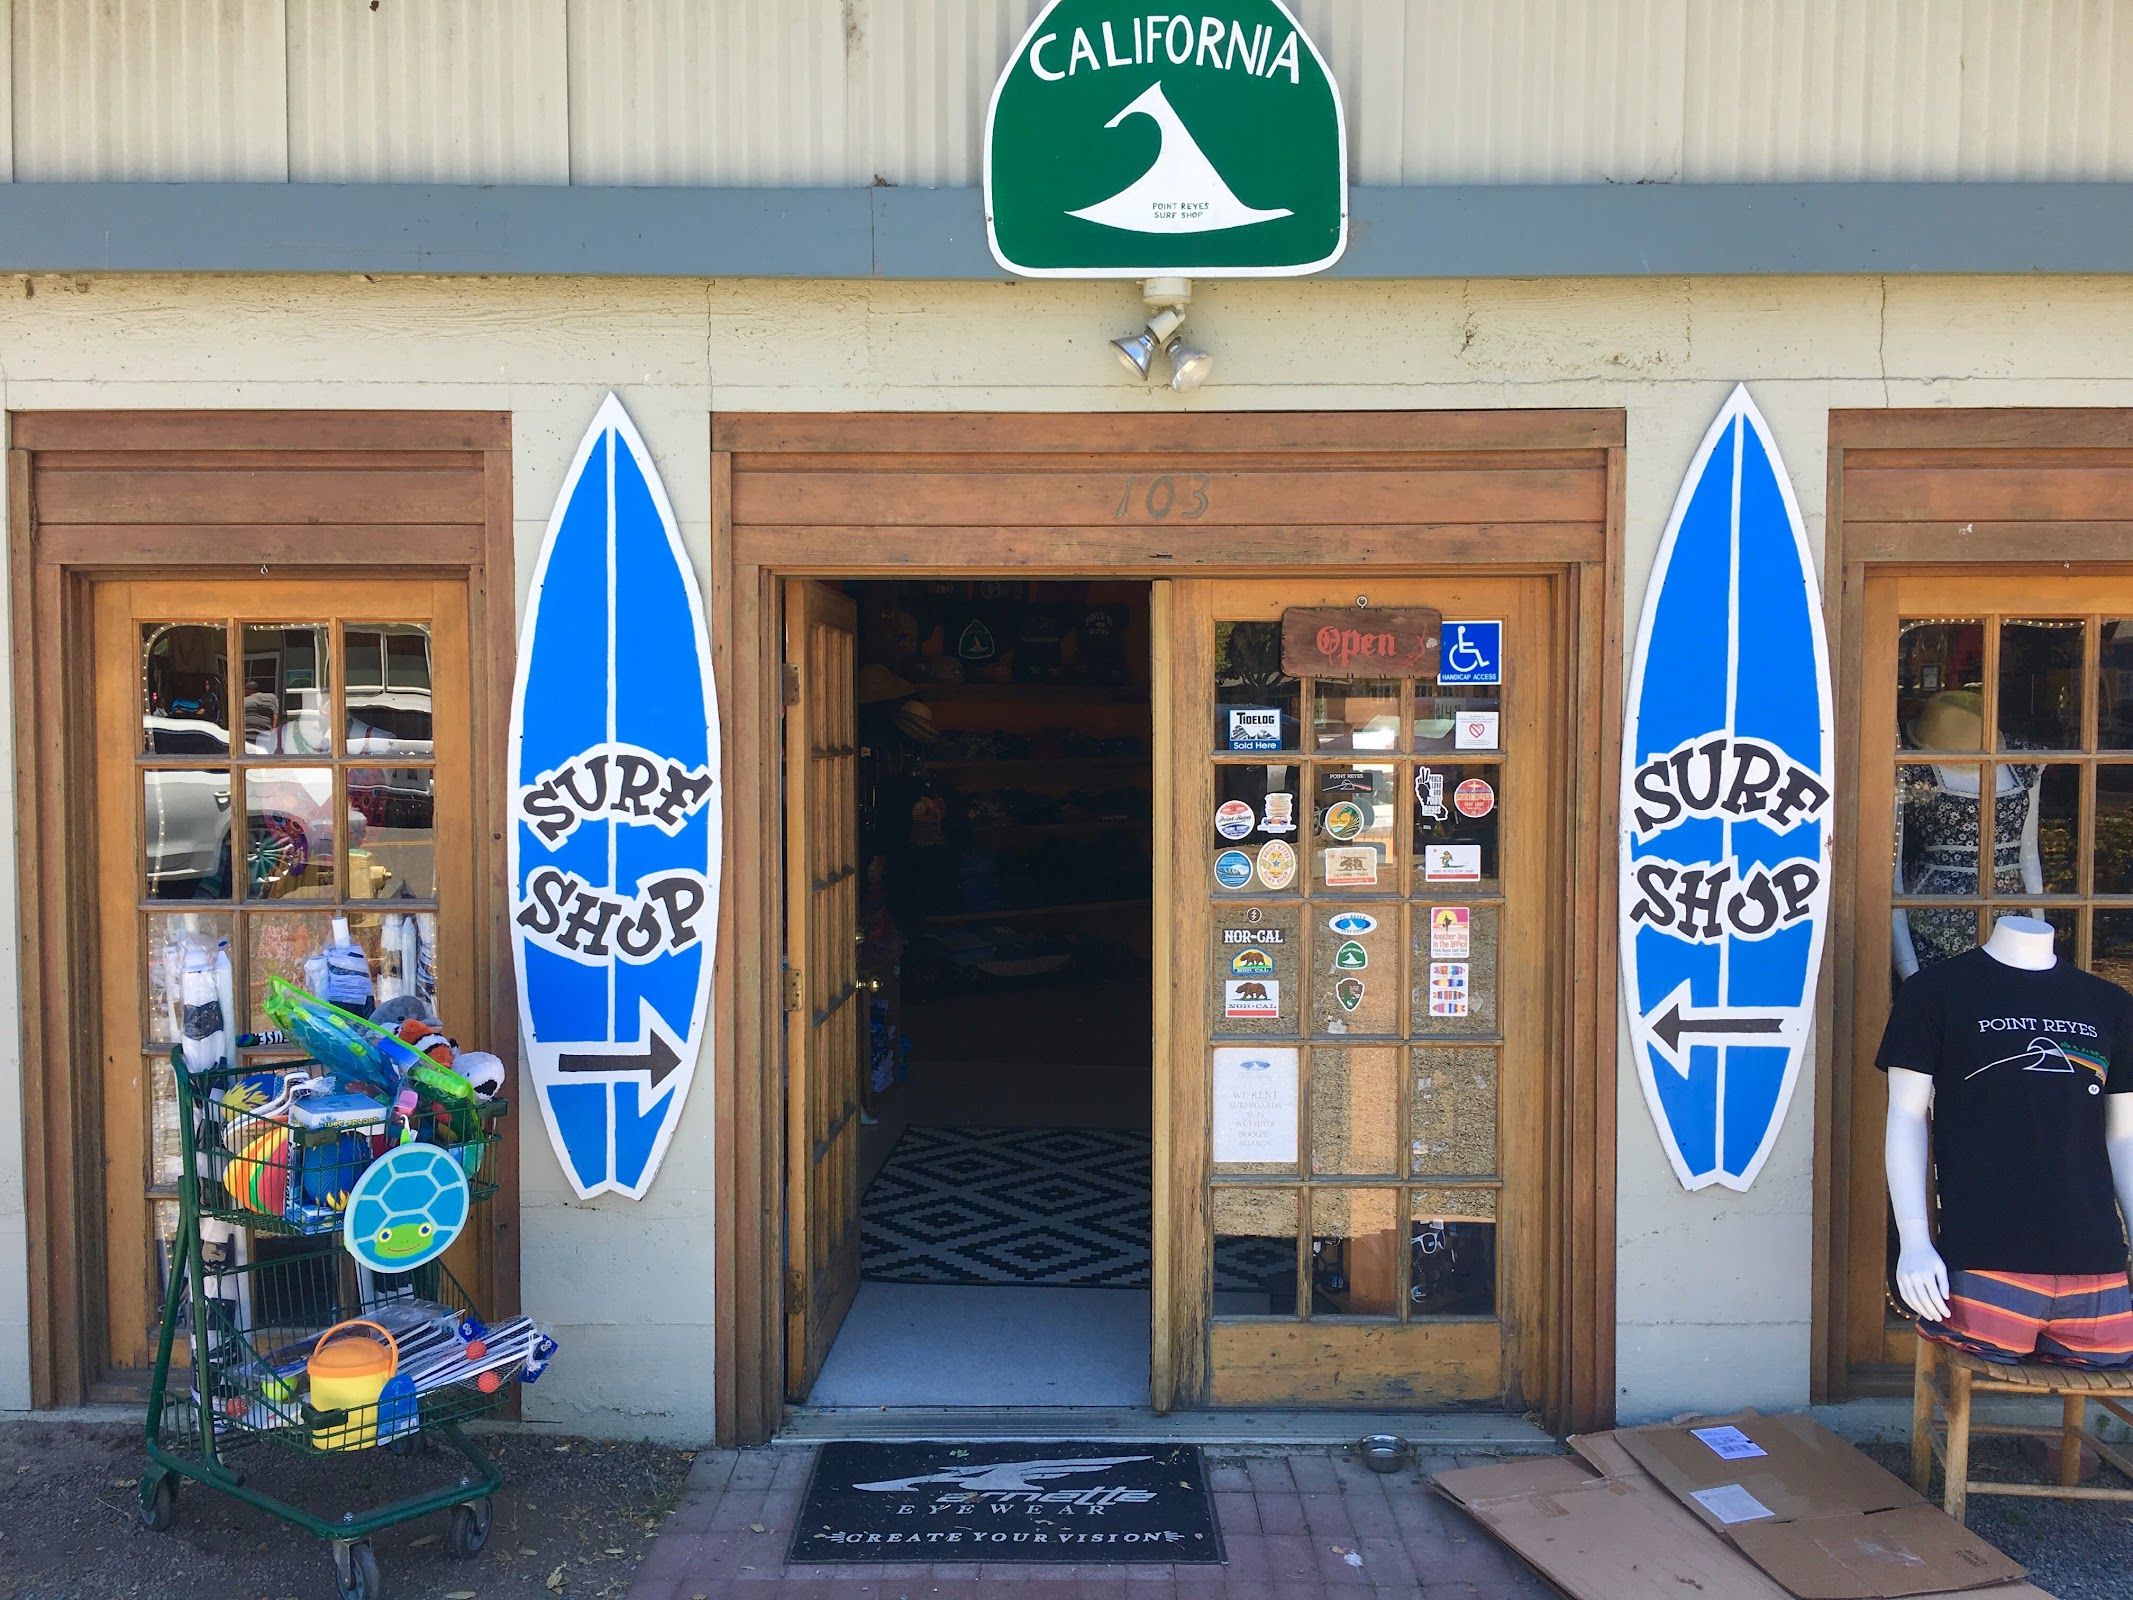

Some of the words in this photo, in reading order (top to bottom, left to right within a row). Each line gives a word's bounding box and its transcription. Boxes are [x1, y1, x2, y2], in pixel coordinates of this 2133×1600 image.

[1030, 14, 1299, 84] CALIFORNIA
[1152, 202, 1178, 210] POINT
[1180, 202, 1210, 210] REYES
[1154, 211, 1177, 219] SURF
[1181, 211, 1204, 219] SHOP
[1112, 474, 1209, 520] 103
[1316, 625, 1396, 667] Open
[1442, 673, 1471, 681] HANDICAP
[1473, 673, 1497, 681] ACCESS
[1236, 712, 1275, 725] TIDELOG
[1233, 741, 1253, 750] Sold
[1255, 741, 1277, 750] Here
[1634, 738, 1830, 833] SURF
[523, 754, 714, 842] SURF
[1264, 846, 1276, 859] POINT
[1629, 864, 1820, 939] SHOP
[516, 871, 705, 957] SHOP
[1224, 929, 1284, 944] NOR-CAL
[1977, 1017, 2037, 1034] POINT
[2041, 1018, 2098, 1039] REYES
[1251, 1090, 1279, 1099] RENT
[1229, 1101, 1283, 1110] SURFBOARDS
[895, 1503, 1106, 1515] EYEWEAR
[845, 1531, 963, 1543] CREATE
[972, 1531, 1049, 1543] YOUR
[1058, 1531, 1163, 1543] VISION
